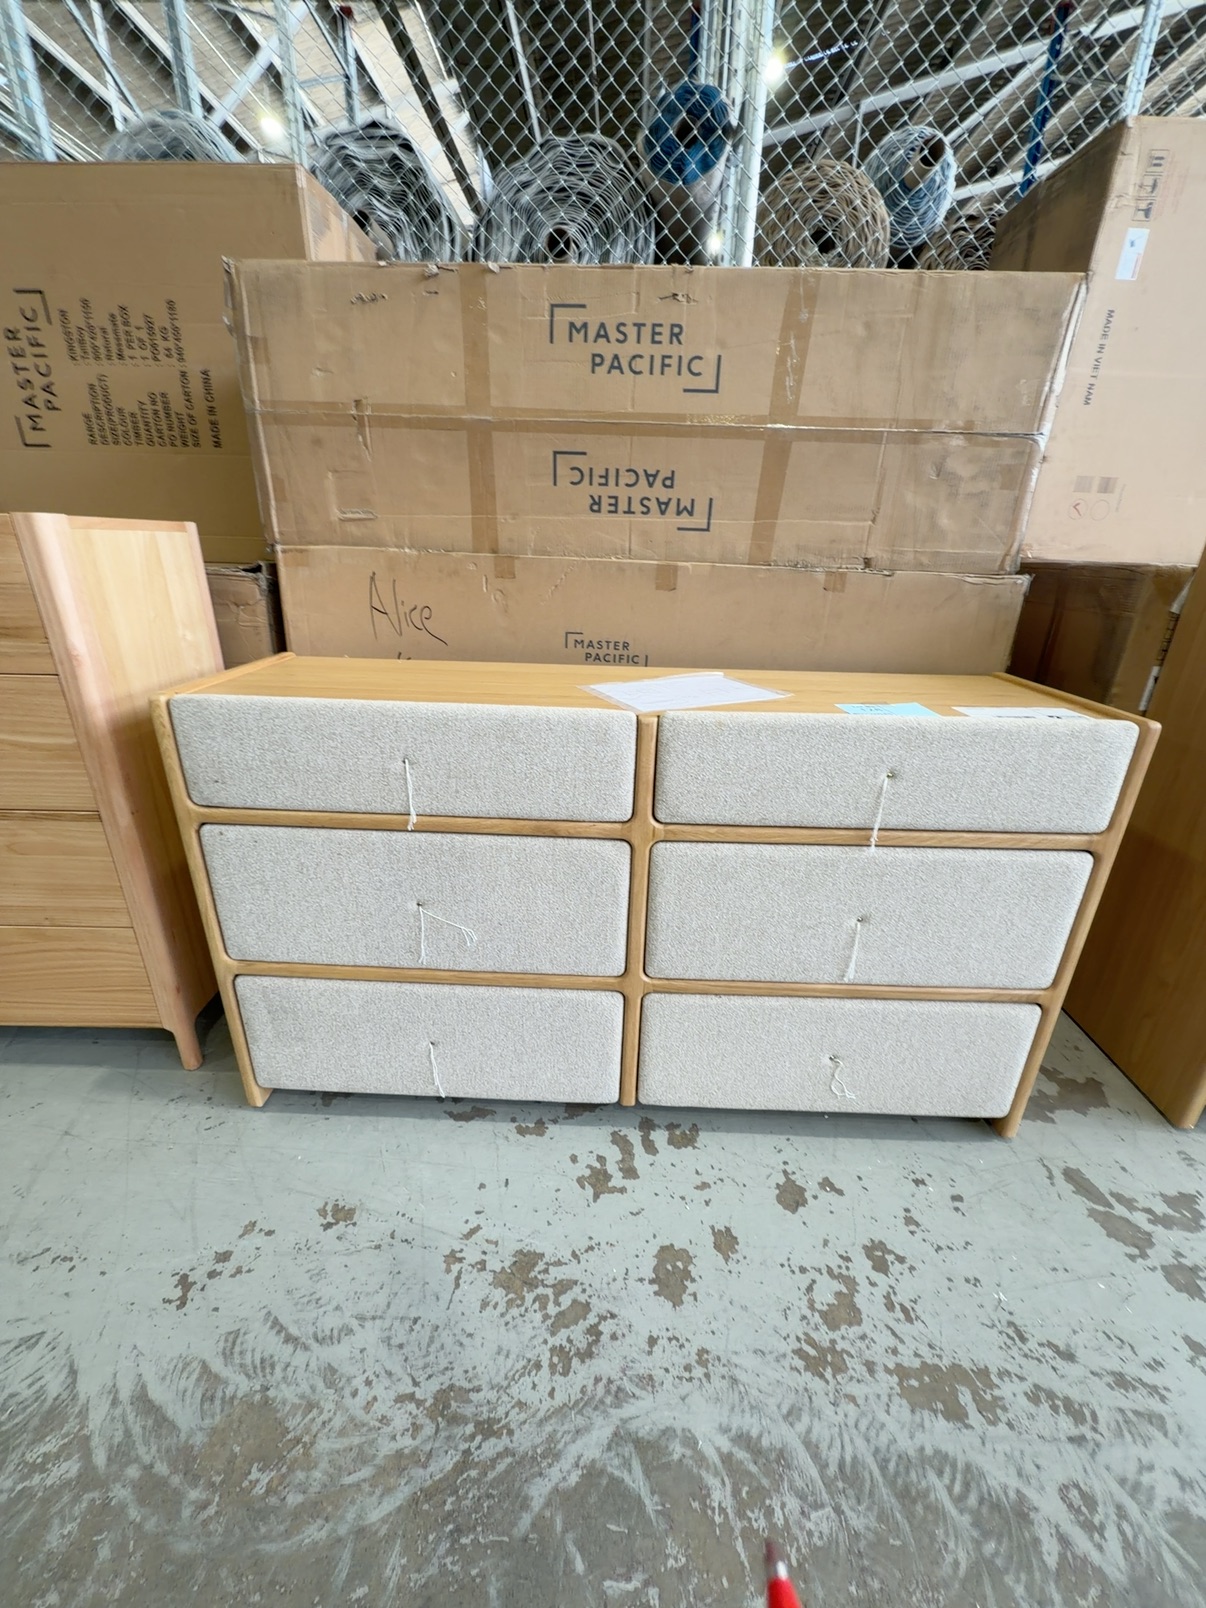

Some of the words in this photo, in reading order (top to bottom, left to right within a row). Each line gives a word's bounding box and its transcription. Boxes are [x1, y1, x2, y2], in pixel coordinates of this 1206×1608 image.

[118, 305, 131, 327] BOX
[1101, 309, 1116, 340] MADE
[57, 309, 79, 362] KINGSTON
[99, 326, 114, 361] Natural
[123, 330, 137, 350] PER
[138, 336, 148, 350] OF
[159, 326, 172, 342] KG
[568, 321, 685, 346] MASTER
[19, 305, 62, 412] PACIFIC
[1096, 343, 1107, 354] IN
[590, 352, 705, 377] PACIFIC
[1090, 357, 1103, 380] VIET
[3, 326, 46, 432] MASTER
[178, 371, 194, 410] CARTON
[200, 369, 215, 403] CHINA
[147, 392, 158, 407] NO
[1083, 383, 1096, 406] NAM
[87, 383, 110, 445] DESCRIPTION
[96, 374, 121, 446] SIZE(PRODUCT)
[137, 400, 155, 447] QUANTITY
[159, 392, 174, 432] NUMBER
[186, 412, 196, 425] OF
[204, 406, 217, 416] IN
[82, 412, 98, 445] RANGE
[117, 407, 132, 446] COLOUR
[129, 411, 143, 446] TIMBER
[151, 408, 167, 447] CARTON
[176, 411, 189, 448] WEIGHT
[188, 428, 201, 448] SIZE
[208, 420, 223, 449] MADE
[167, 434, 178, 448] PO
[569, 467, 676, 489] PACIFIC
[588, 495, 696, 517] MASTER
[369, 571, 448, 646] Alice
[574, 638, 631, 652] MASTER
[584, 652, 640, 665] PACIFIC
